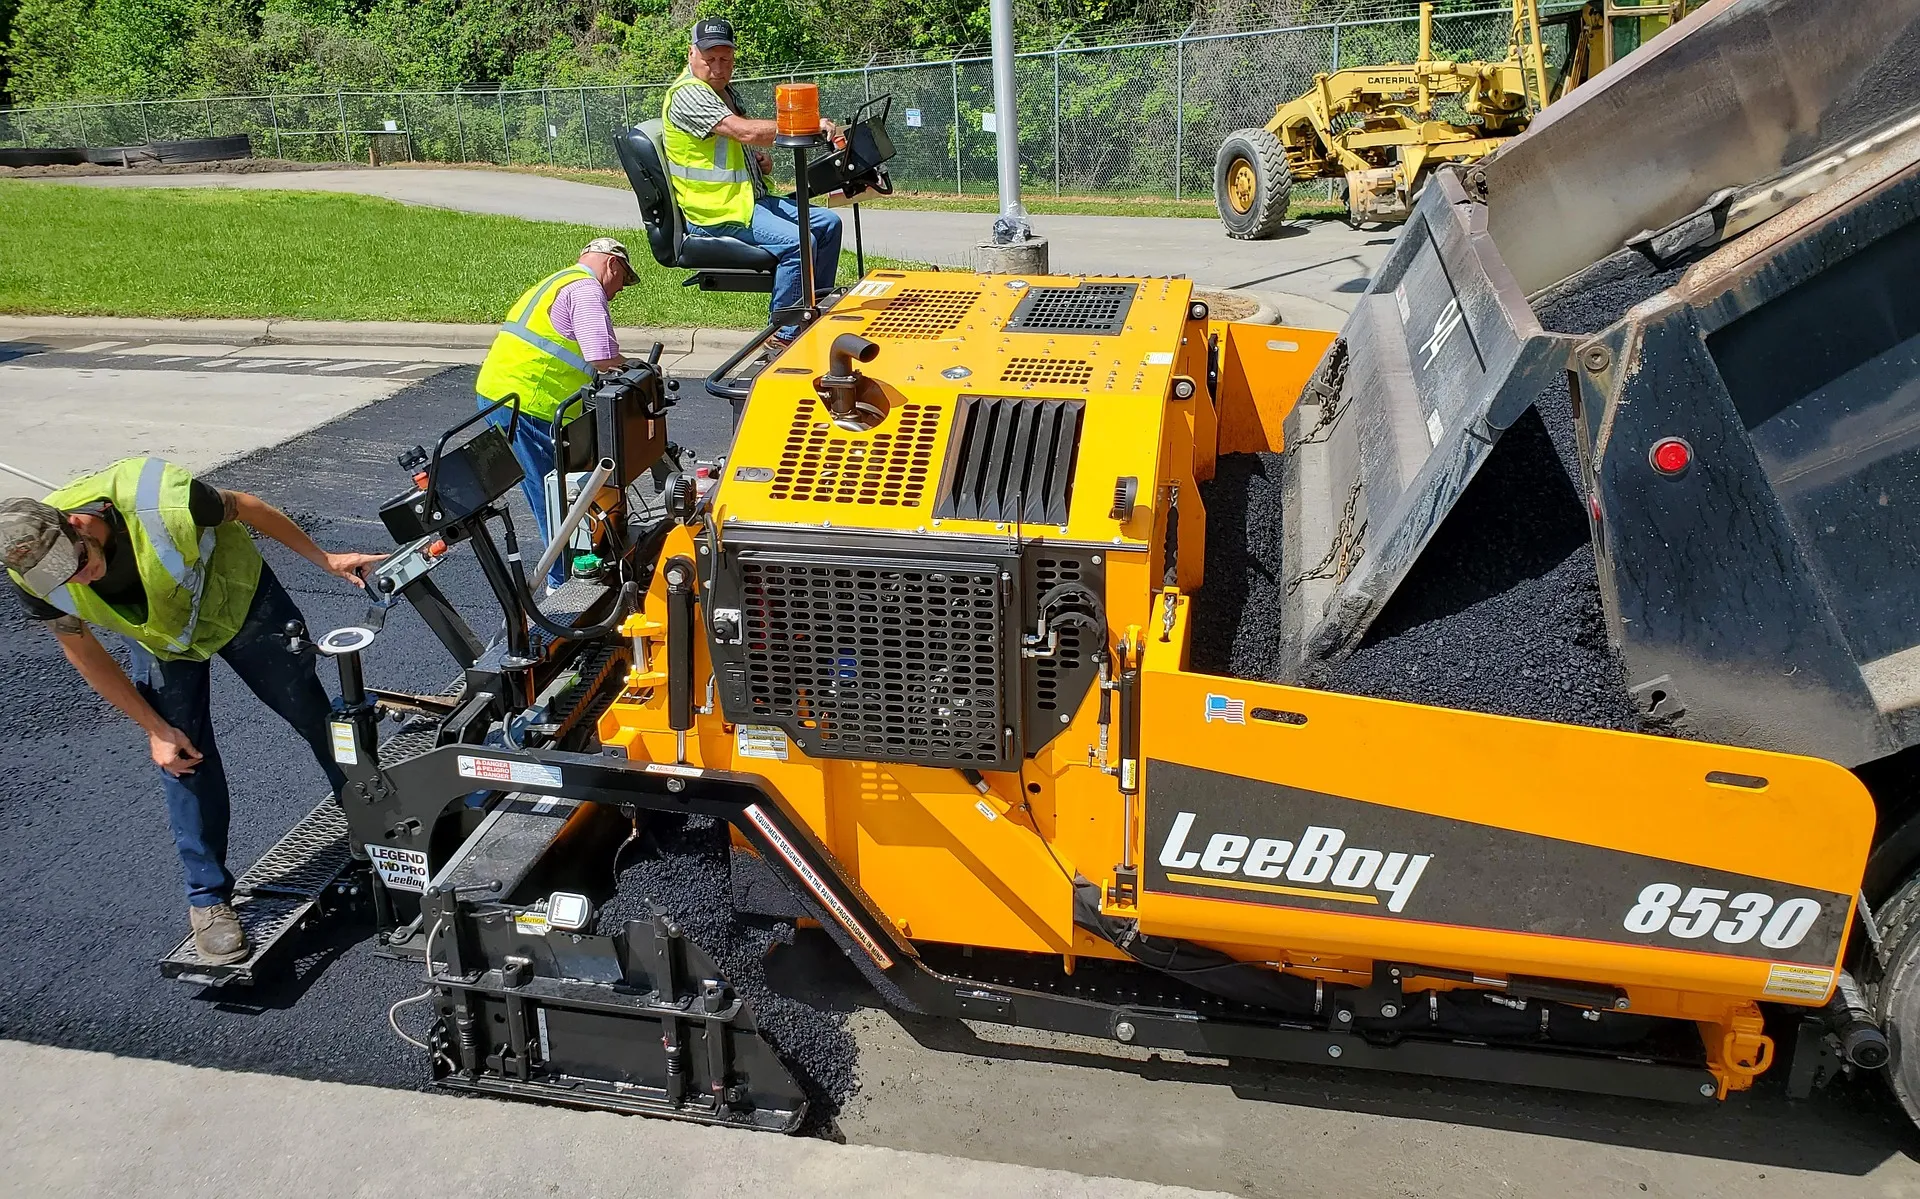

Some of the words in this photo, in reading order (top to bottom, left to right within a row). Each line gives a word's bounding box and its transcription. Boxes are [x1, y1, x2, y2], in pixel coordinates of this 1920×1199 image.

[483, 760, 508, 768] DANGER
[372, 848, 425, 864] LEGEND
[1158, 811, 1431, 913] LeeBoy
[401, 864, 426, 876] PRO
[387, 873, 425, 890] LeeBoy
[780, 841, 803, 868] DESIGNED
[800, 864, 814, 881] WITH
[811, 877, 822, 891] THE
[820, 888, 838, 908] PAVING
[835, 905, 867, 944] PROFESSIONAL
[865, 941, 873, 949] IN
[1623, 882, 1822, 949] 8530
